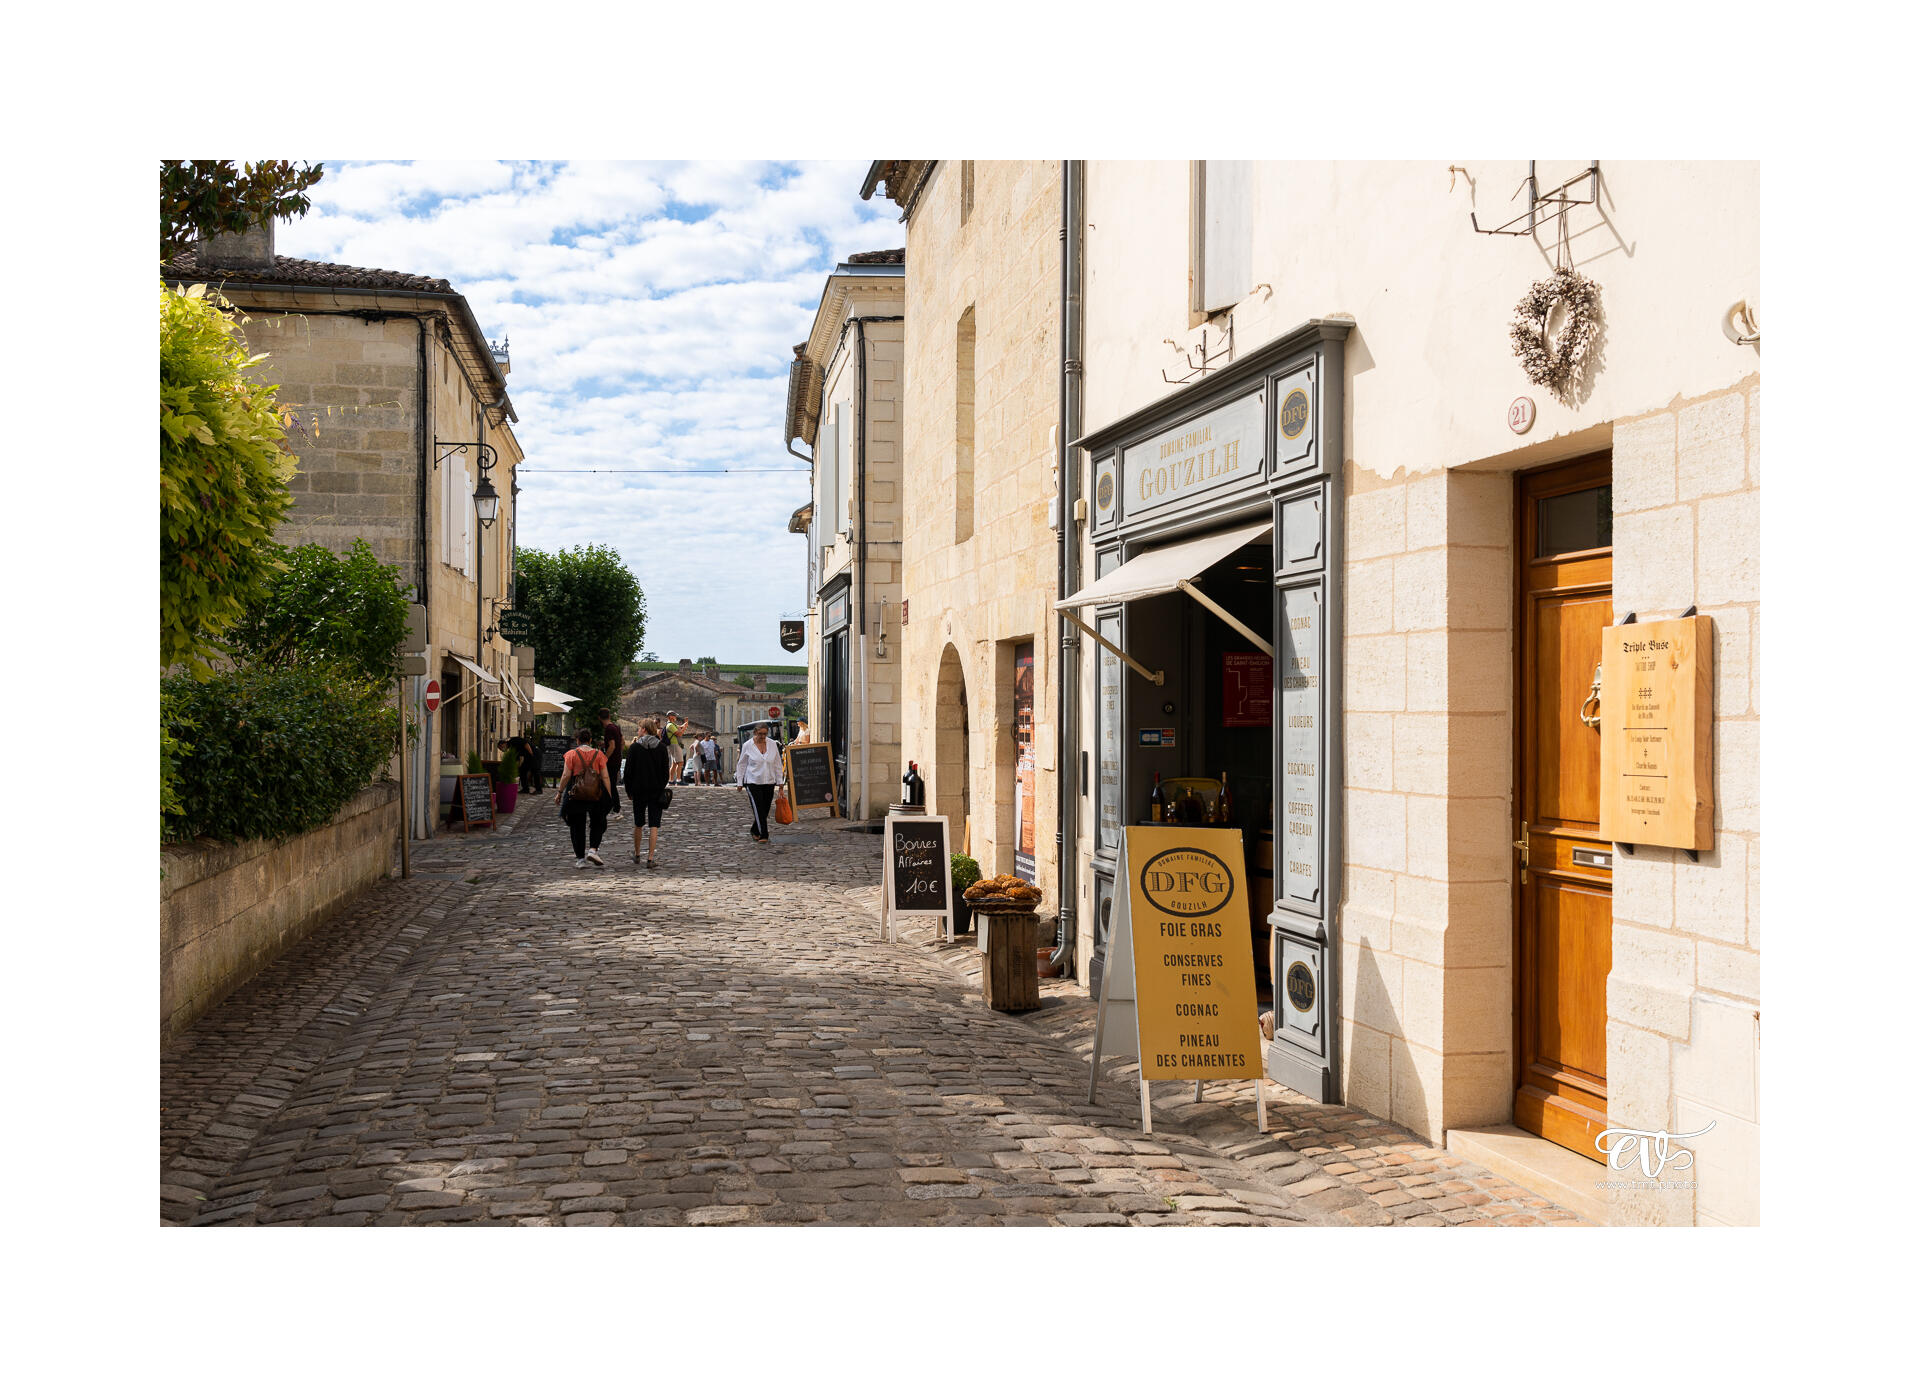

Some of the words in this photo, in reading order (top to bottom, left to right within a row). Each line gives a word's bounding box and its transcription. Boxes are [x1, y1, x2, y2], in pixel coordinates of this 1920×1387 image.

[1283, 403, 1307, 427] DFG
[1512, 403, 1527, 426] 21
[1160, 437, 1184, 460] DOMAINE
[1184, 424, 1213, 449] FAMILIAL
[1139, 439, 1241, 501] GOUZILH
[1290, 616, 1312, 631] COGNAC
[1291, 656, 1311, 670] PINEAU
[1283, 676, 1292, 689] DES
[1293, 675, 1318, 689] CHARENTES
[1288, 715, 1313, 729] LIQUEURS
[1287, 762, 1316, 777] COCKTAILS
[1288, 801, 1314, 817] COFFRETS
[1289, 821, 1313, 837] CADEAUX
[895, 832, 937, 851] Bonnes
[898, 855, 933, 869] Affaires
[1158, 854, 1184, 868] DOMAINE
[1186, 854, 1215, 868] FAMILIAL
[1289, 860, 1312, 877] CARAFES
[905, 877, 938, 894] 10€
[1148, 871, 1226, 894] DFG
[1171, 900, 1208, 911] GOUZILH
[1160, 923, 1187, 938] FOIE
[1190, 923, 1222, 938] GRAS
[1163, 954, 1223, 968] CONSERVES
[1181, 974, 1212, 987] FINES
[1175, 1003, 1219, 1017] COGNAC
[1179, 1034, 1220, 1048] PINEAU
[1156, 1054, 1177, 1068] DES
[1181, 1054, 1246, 1068] CHARENTES
